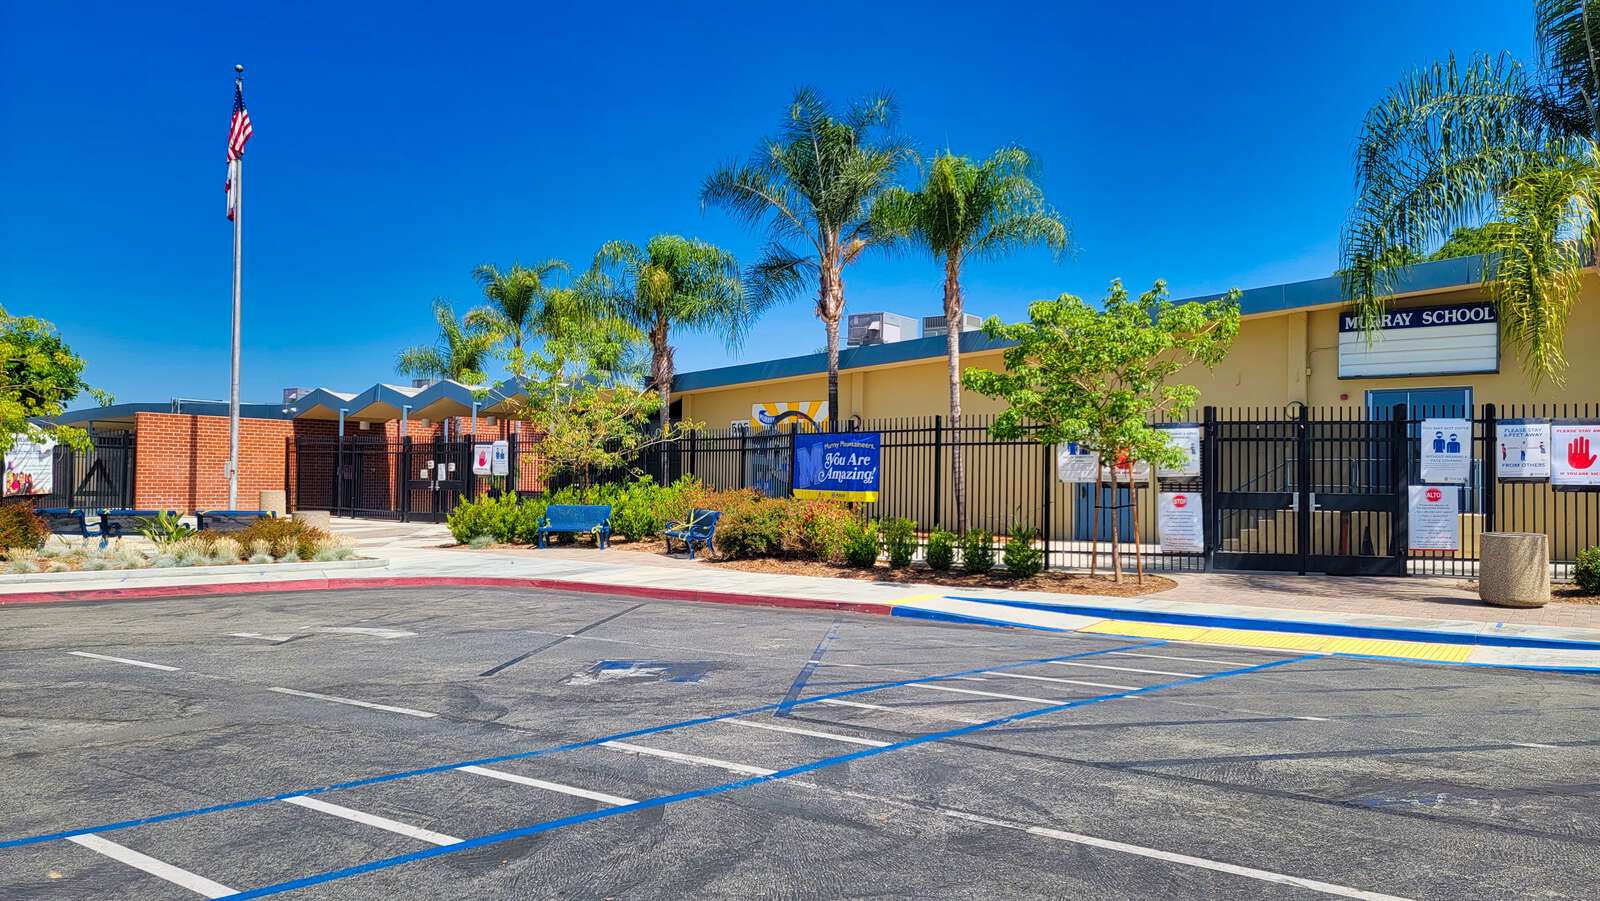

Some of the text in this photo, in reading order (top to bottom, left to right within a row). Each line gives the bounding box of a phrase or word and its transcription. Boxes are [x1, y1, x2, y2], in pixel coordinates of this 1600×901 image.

[1422, 307, 1494, 325] SCHOOL
[824, 452, 871, 469] You Are
[818, 467, 876, 484] Amazing!
